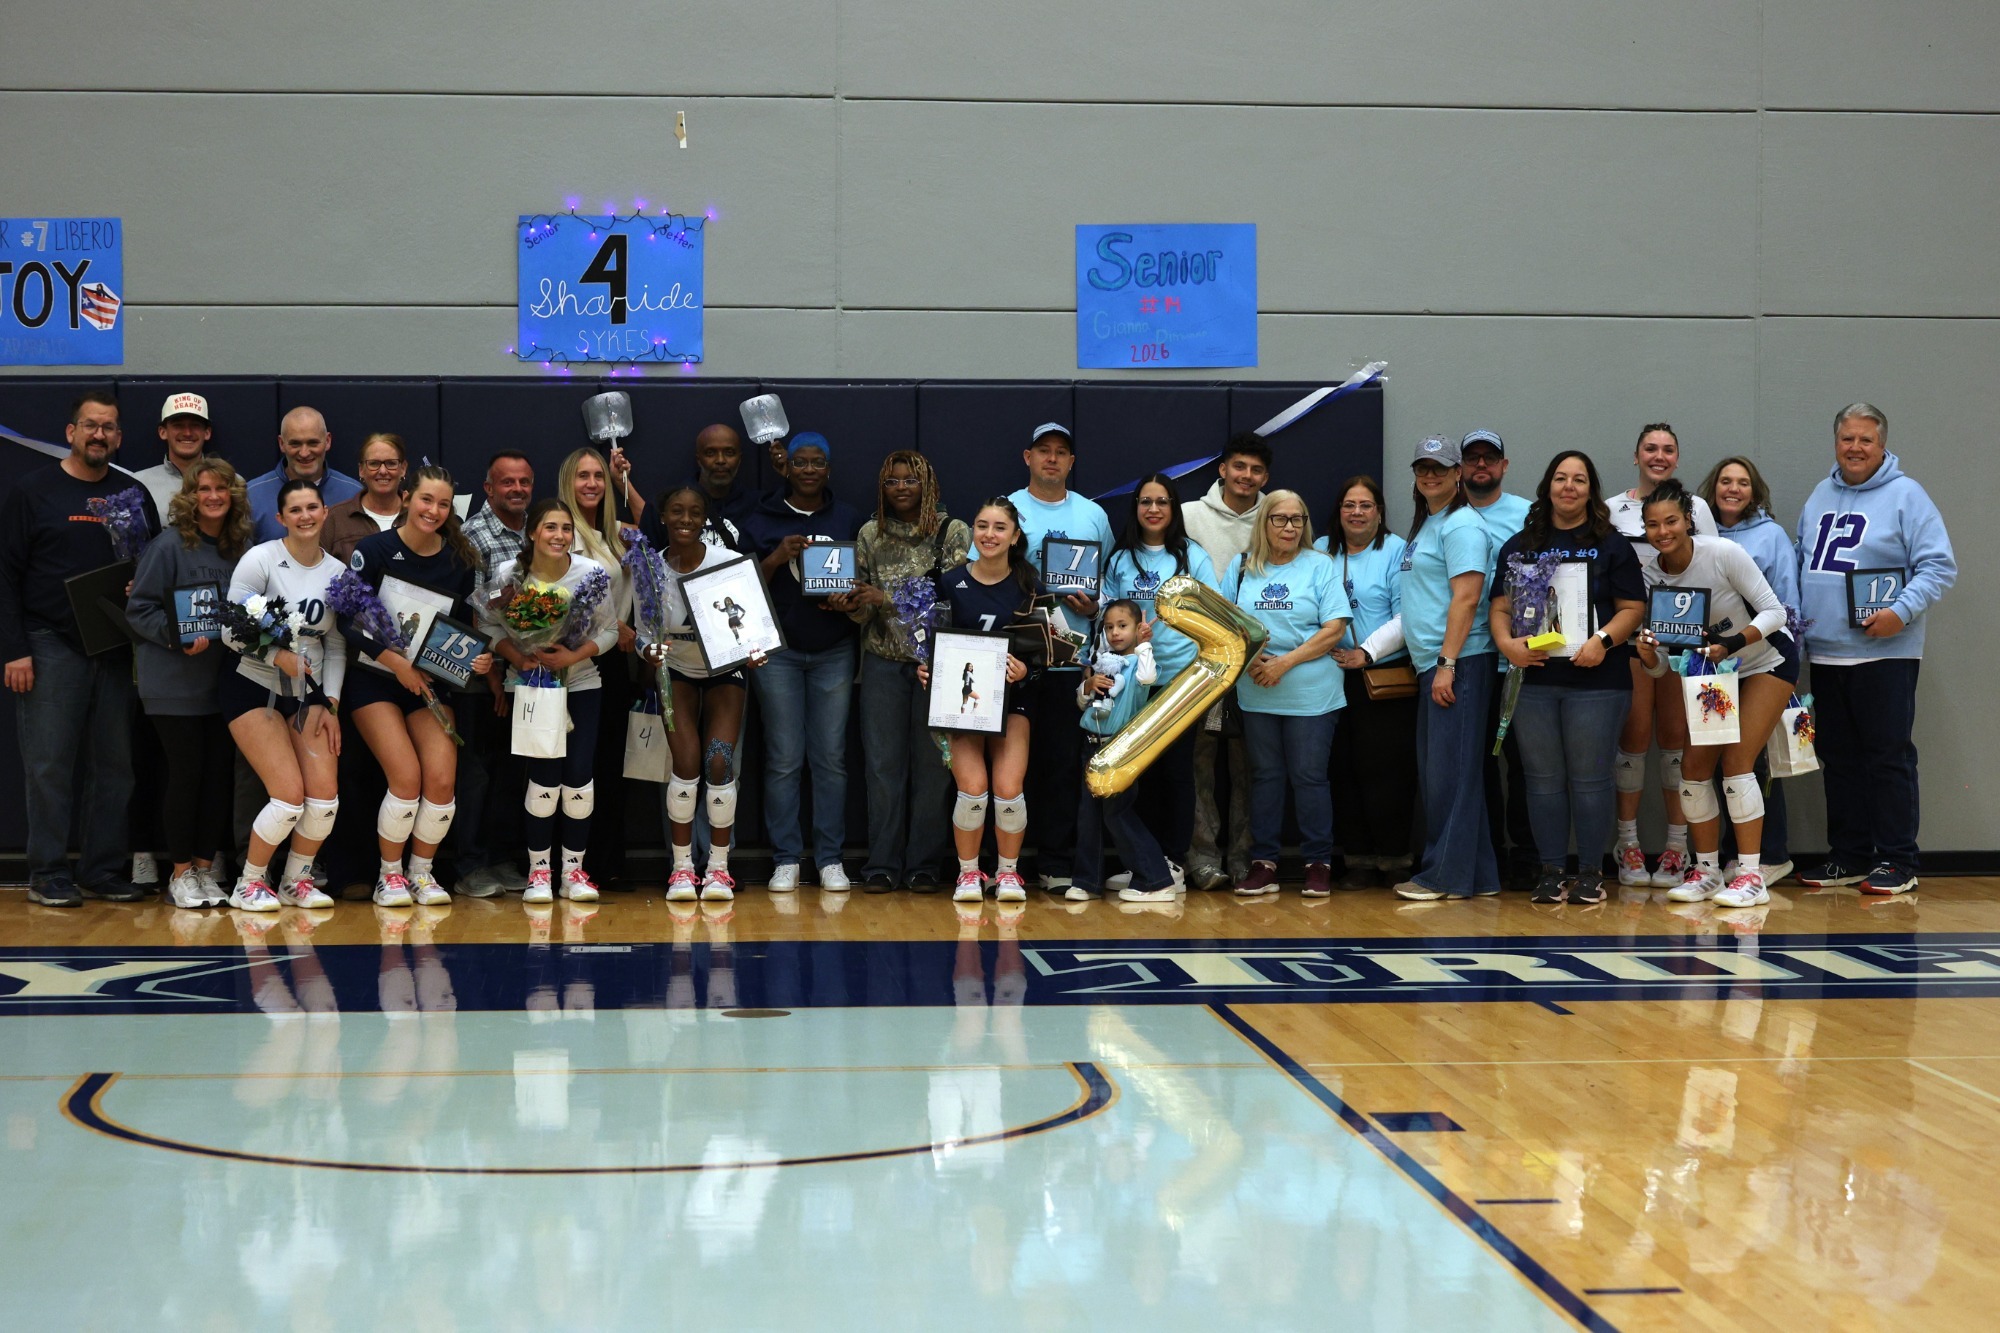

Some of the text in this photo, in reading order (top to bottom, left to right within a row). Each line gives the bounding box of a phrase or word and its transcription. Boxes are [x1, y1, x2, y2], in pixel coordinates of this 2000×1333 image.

[21, 221, 49, 251] #7
[54, 221, 114, 251] LIBERO
[524, 222, 561, 250] Senior
[659, 223, 695, 250] Setter
[1087, 232, 1223, 292] Senior
[579, 234, 628, 325] 4
[576, 329, 650, 353] SYKES
[1130, 343, 1170, 363] 2026
[174, 395, 191, 404] KING
[174, 402, 202, 412] HEARTS
[1574, 548, 1598, 560] #9
[1808, 510, 1870, 577] 12
[823, 547, 842, 575] 4
[1067, 545, 1086, 572] 7
[805, 578, 856, 590] TRINIT
[1046, 571, 1098, 590] TRINITY
[1866, 575, 1898, 604] 12
[188, 588, 213, 618] 10
[297, 598, 325, 626] 10
[1674, 592, 1693, 618] 9
[978, 614, 997, 631] 7
[1651, 620, 1704, 637] TRINITY
[437, 631, 478, 661] 15
[421, 647, 472, 683] TRINITY
[522, 701, 536, 723] 14
[639, 726, 652, 748] 4
